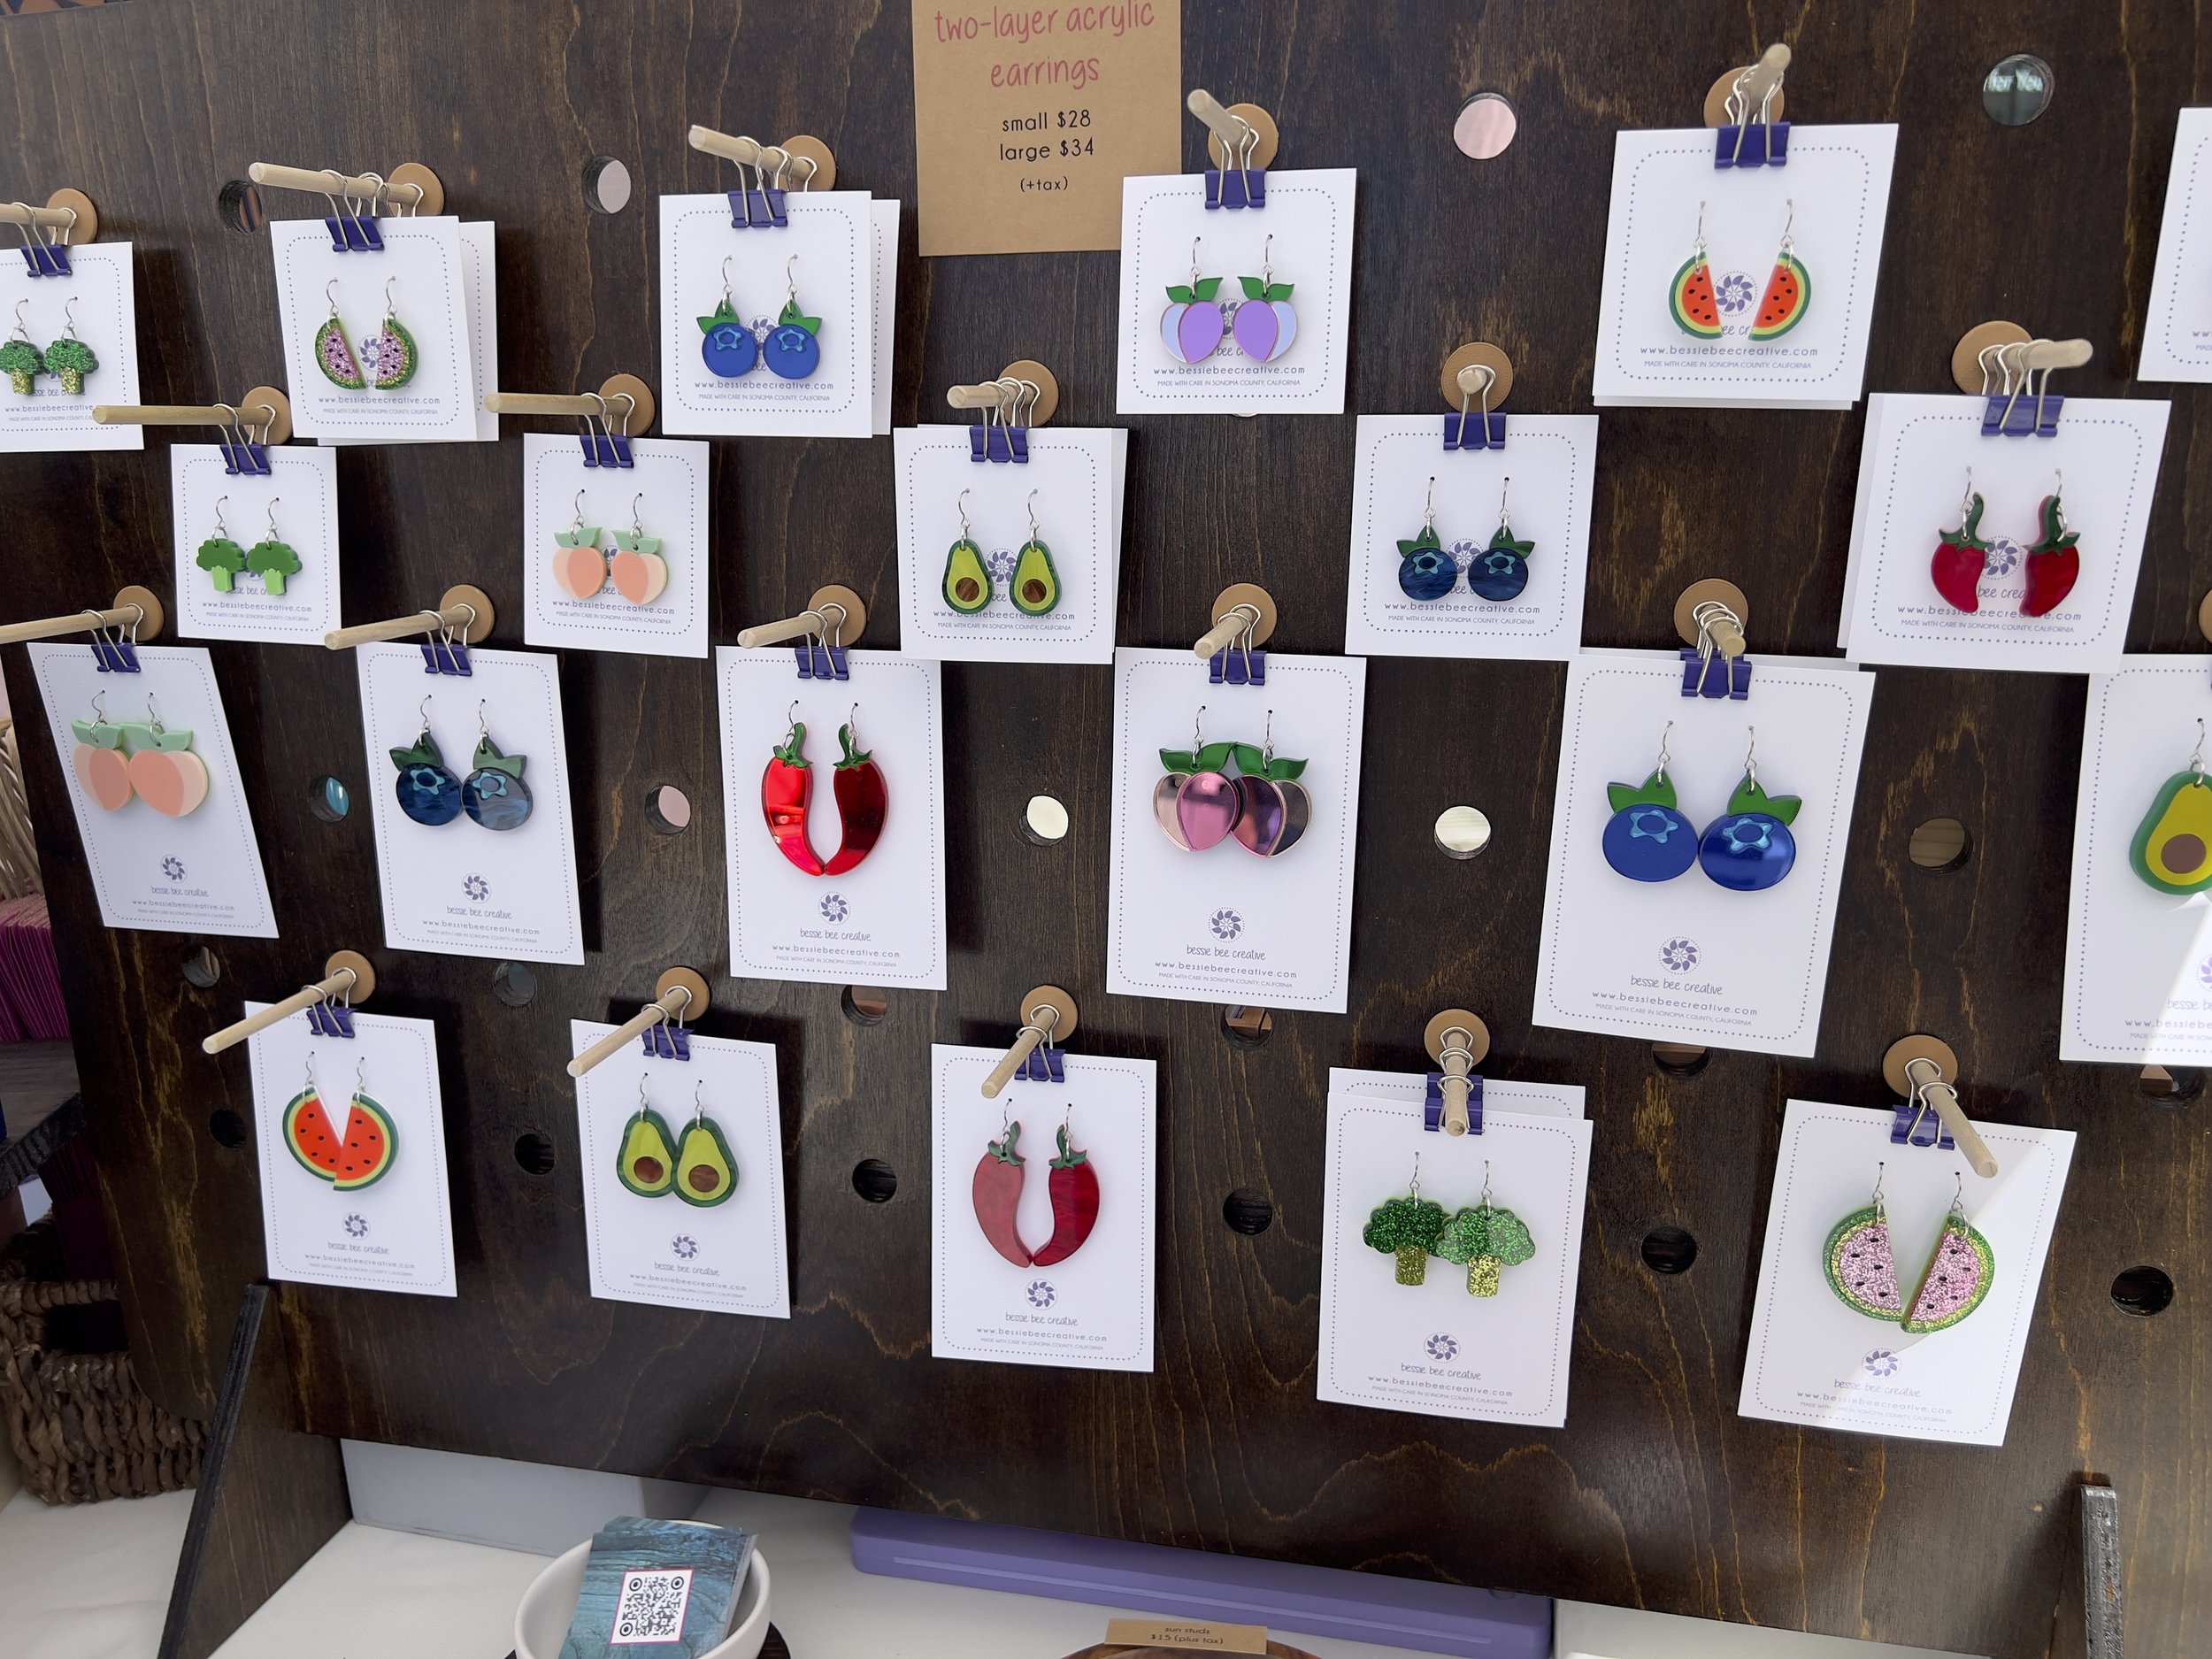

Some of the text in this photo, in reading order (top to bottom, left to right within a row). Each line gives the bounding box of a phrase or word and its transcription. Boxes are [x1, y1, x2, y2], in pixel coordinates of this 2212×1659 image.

[935, 0, 1155, 43] two-layer acrylic
[990, 56, 1100, 89] earrings
[1002, 110, 1091, 132] small $28
[1000, 136, 1094, 161] large $34
[1020, 176, 1069, 192] (+tax)
[1217, 344, 1233, 357] bee
[1640, 345, 1819, 356] www.bessiebeecreative.com
[694, 380, 833, 389] www.bessiebeecreative.com
[1977, 586, 1996, 599] bee
[1384, 602, 1540, 613] www.bessiebeecreative.com
[825, 929, 838, 939] bee
[772, 945, 900, 957] www.bessiebeecreative.com
[1187, 944, 1266, 960] bessie bee creative
[1155, 961, 1297, 979] www.bessiebeecreative.com
[1631, 974, 1723, 995] bessie bee creative
[1593, 992, 1757, 1016] www.bessiebeecreative.com
[1655, 1010, 1685, 1018] SONOMA
[1031, 1313, 1044, 1324] bee
[976, 1327, 1107, 1341] www.bessiebeecreative.com
[1429, 1365, 1444, 1376] bee
[1368, 1376, 1513, 1397] www.bessiebeecreative.com
